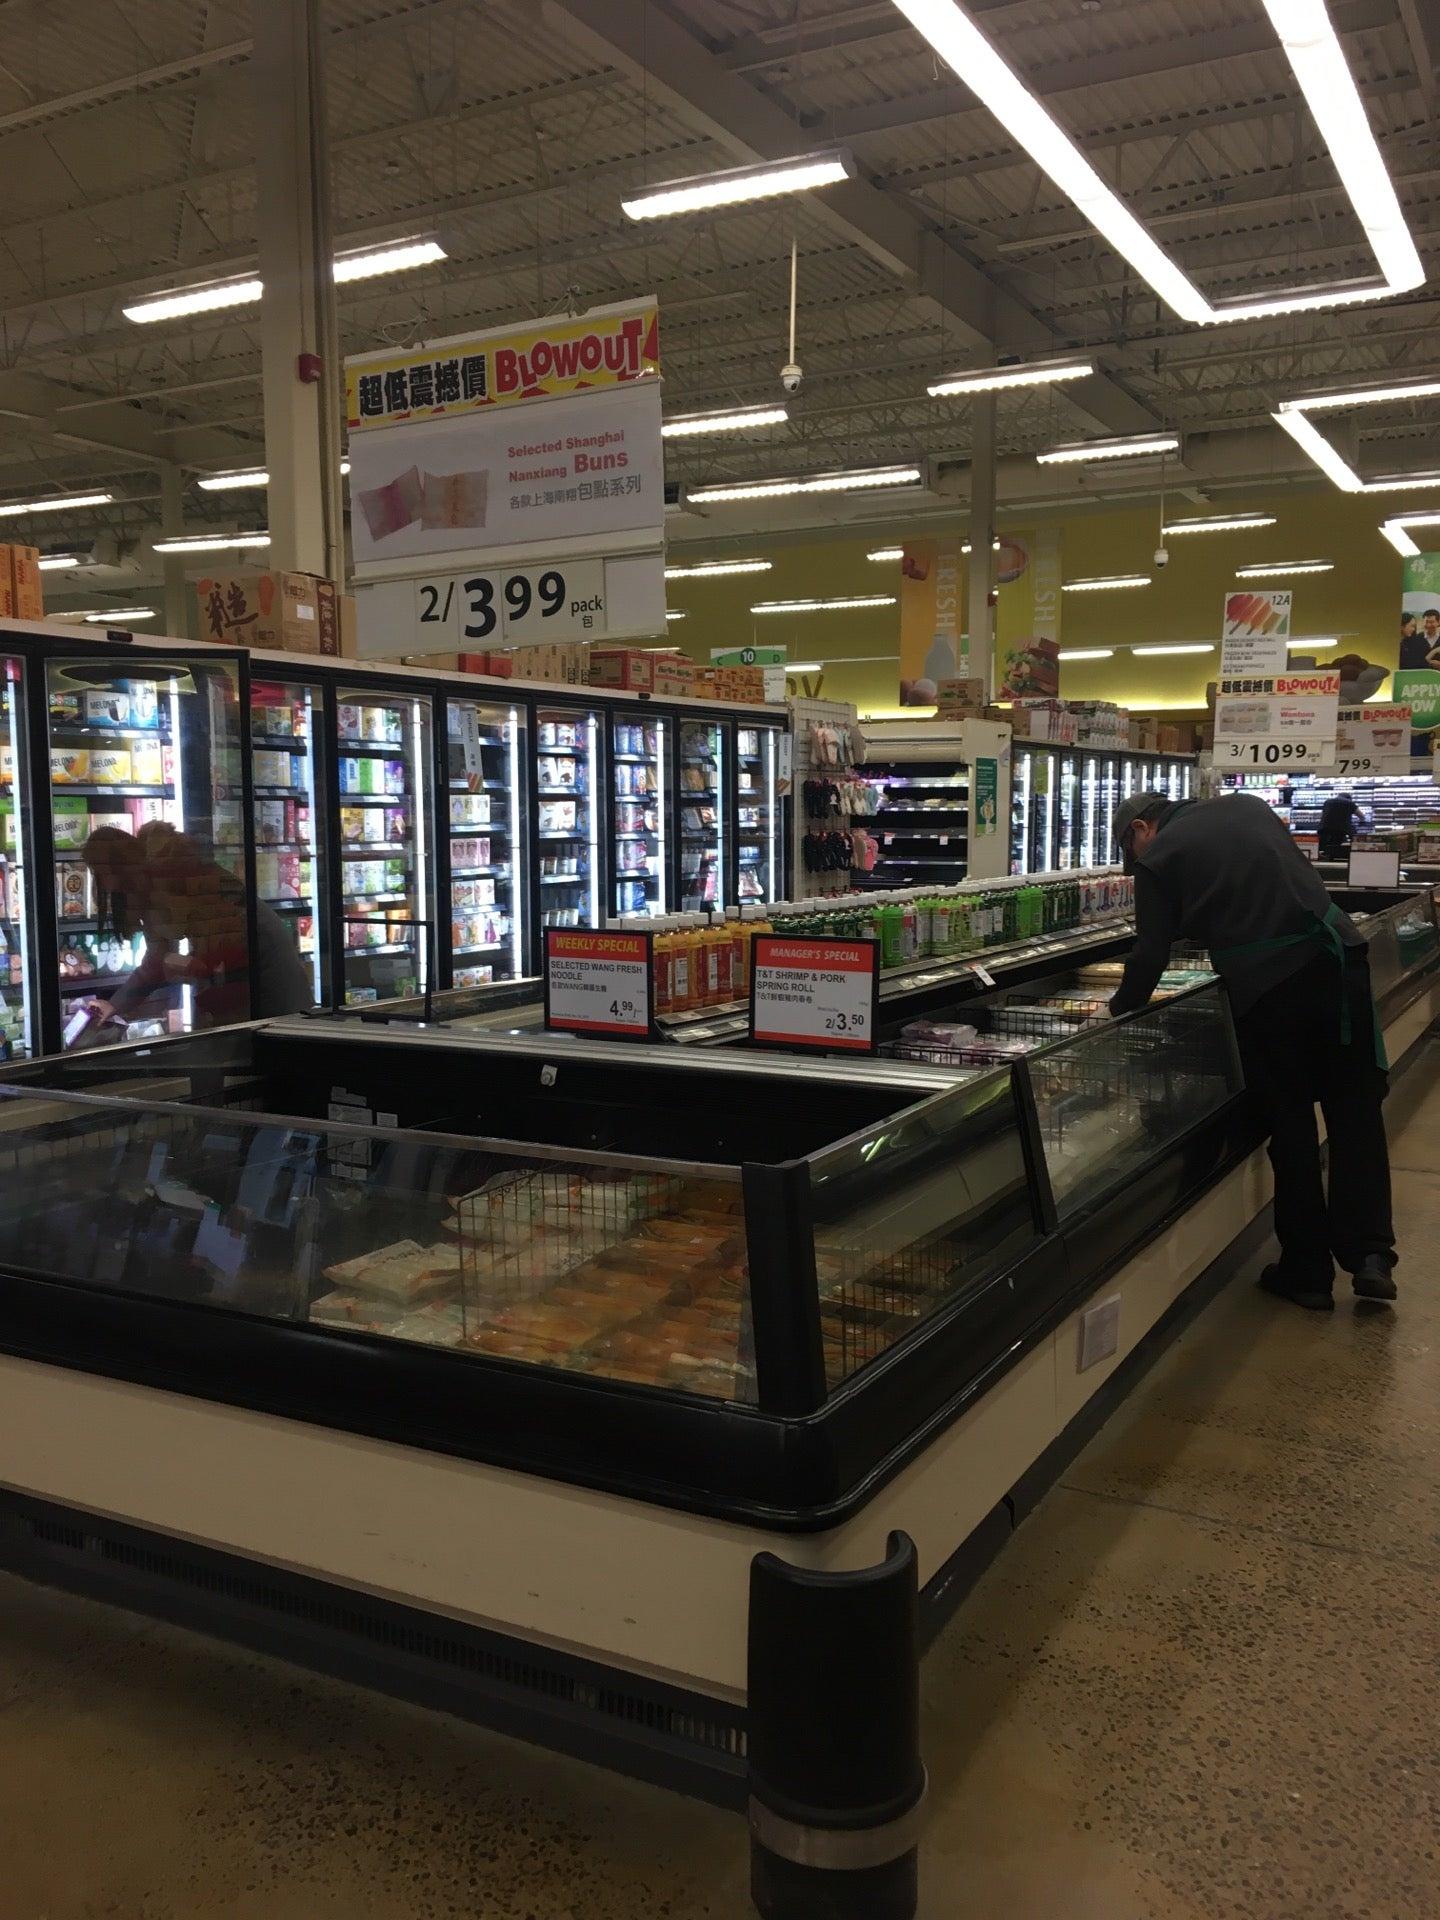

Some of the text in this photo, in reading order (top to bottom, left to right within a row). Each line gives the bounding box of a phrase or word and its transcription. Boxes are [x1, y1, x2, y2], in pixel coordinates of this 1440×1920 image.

[360, 318, 643, 417] 超低震撼價 BLOWOUT
[507, 429, 625, 458] Selected Shanghai
[509, 452, 628, 482] Nanxiang Buns
[570, 595, 603, 617] pack
[1272, 594, 1290, 606] 12A
[582, 615, 594, 629] 包
[742, 650, 754, 662] 10
[1277, 676, 1334, 692] BLOWOUT
[1401, 684, 1440, 697] APPLY
[1410, 699, 1436, 712] OW
[1363, 707, 1408, 720] BLOWOUT
[556, 936, 640, 953] WEEKLY SPECIAL
[769, 947, 860, 962] MANAGER'S SPECIAL
[551, 960, 643, 974] SELECTED WANG FRESH
[551, 971, 583, 980] NOODLE
[757, 969, 846, 983] T&T SHRIMP & PORK
[757, 981, 815, 993] SPRING ROLL
